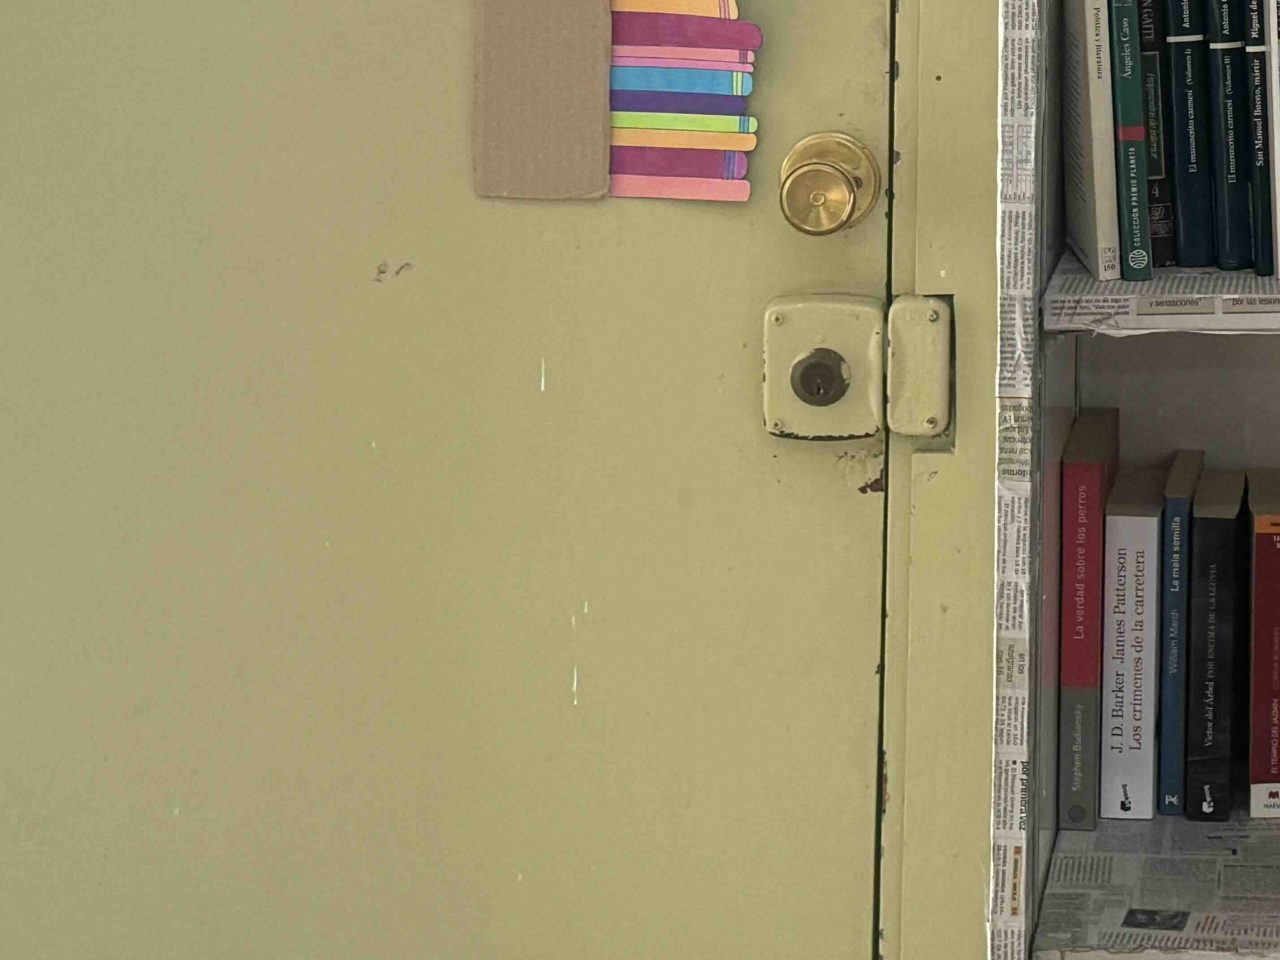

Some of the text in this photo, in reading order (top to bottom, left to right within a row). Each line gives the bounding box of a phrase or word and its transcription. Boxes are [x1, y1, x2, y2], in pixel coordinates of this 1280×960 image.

[1250, 10, 1259, 38] Miguel
[1119, 17, 1133, 79] Ángeles Caso
[1186, 119, 1196, 163] manuscrito
[1226, 130, 1236, 173] manuscrito
[1254, 118, 1262, 150] Manuel
[1255, 151, 1263, 166] San
[1074, 485, 1089, 640] La verdad sobre los perros
[1169, 516, 1181, 675] William March La mala semilla
[1111, 547, 1128, 754] J. D. Barker James Patterson
[1130, 549, 1146, 751] Los crímenes de la carretera
[1205, 706, 1214, 720] del
[1071, 753, 1081, 791] Stephen
